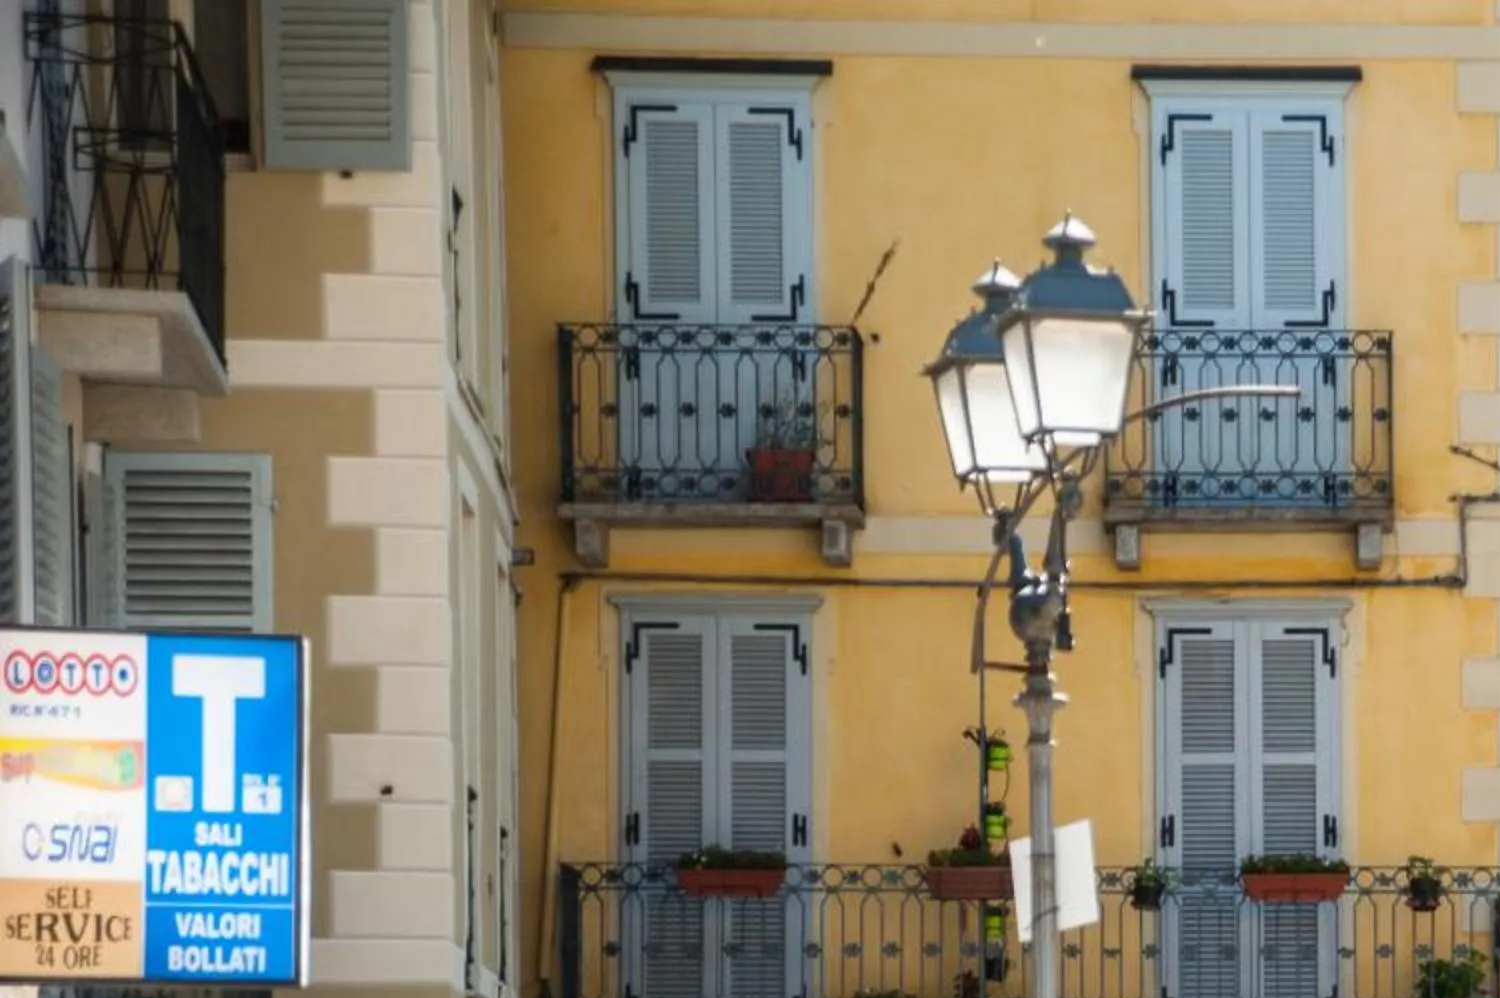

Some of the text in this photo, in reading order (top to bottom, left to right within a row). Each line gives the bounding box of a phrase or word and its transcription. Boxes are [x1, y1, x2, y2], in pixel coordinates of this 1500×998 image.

[4, 649, 138, 697] LOTTO
[172, 654, 266, 812] T
[194, 820, 242, 847] SALI
[147, 850, 289, 896] TABACCHI
[5, 913, 132, 943] SERVICE
[175, 912, 261, 939] VALORI
[35, 945, 103, 970] 24 ORE
[167, 945, 266, 973] BOLLATI
